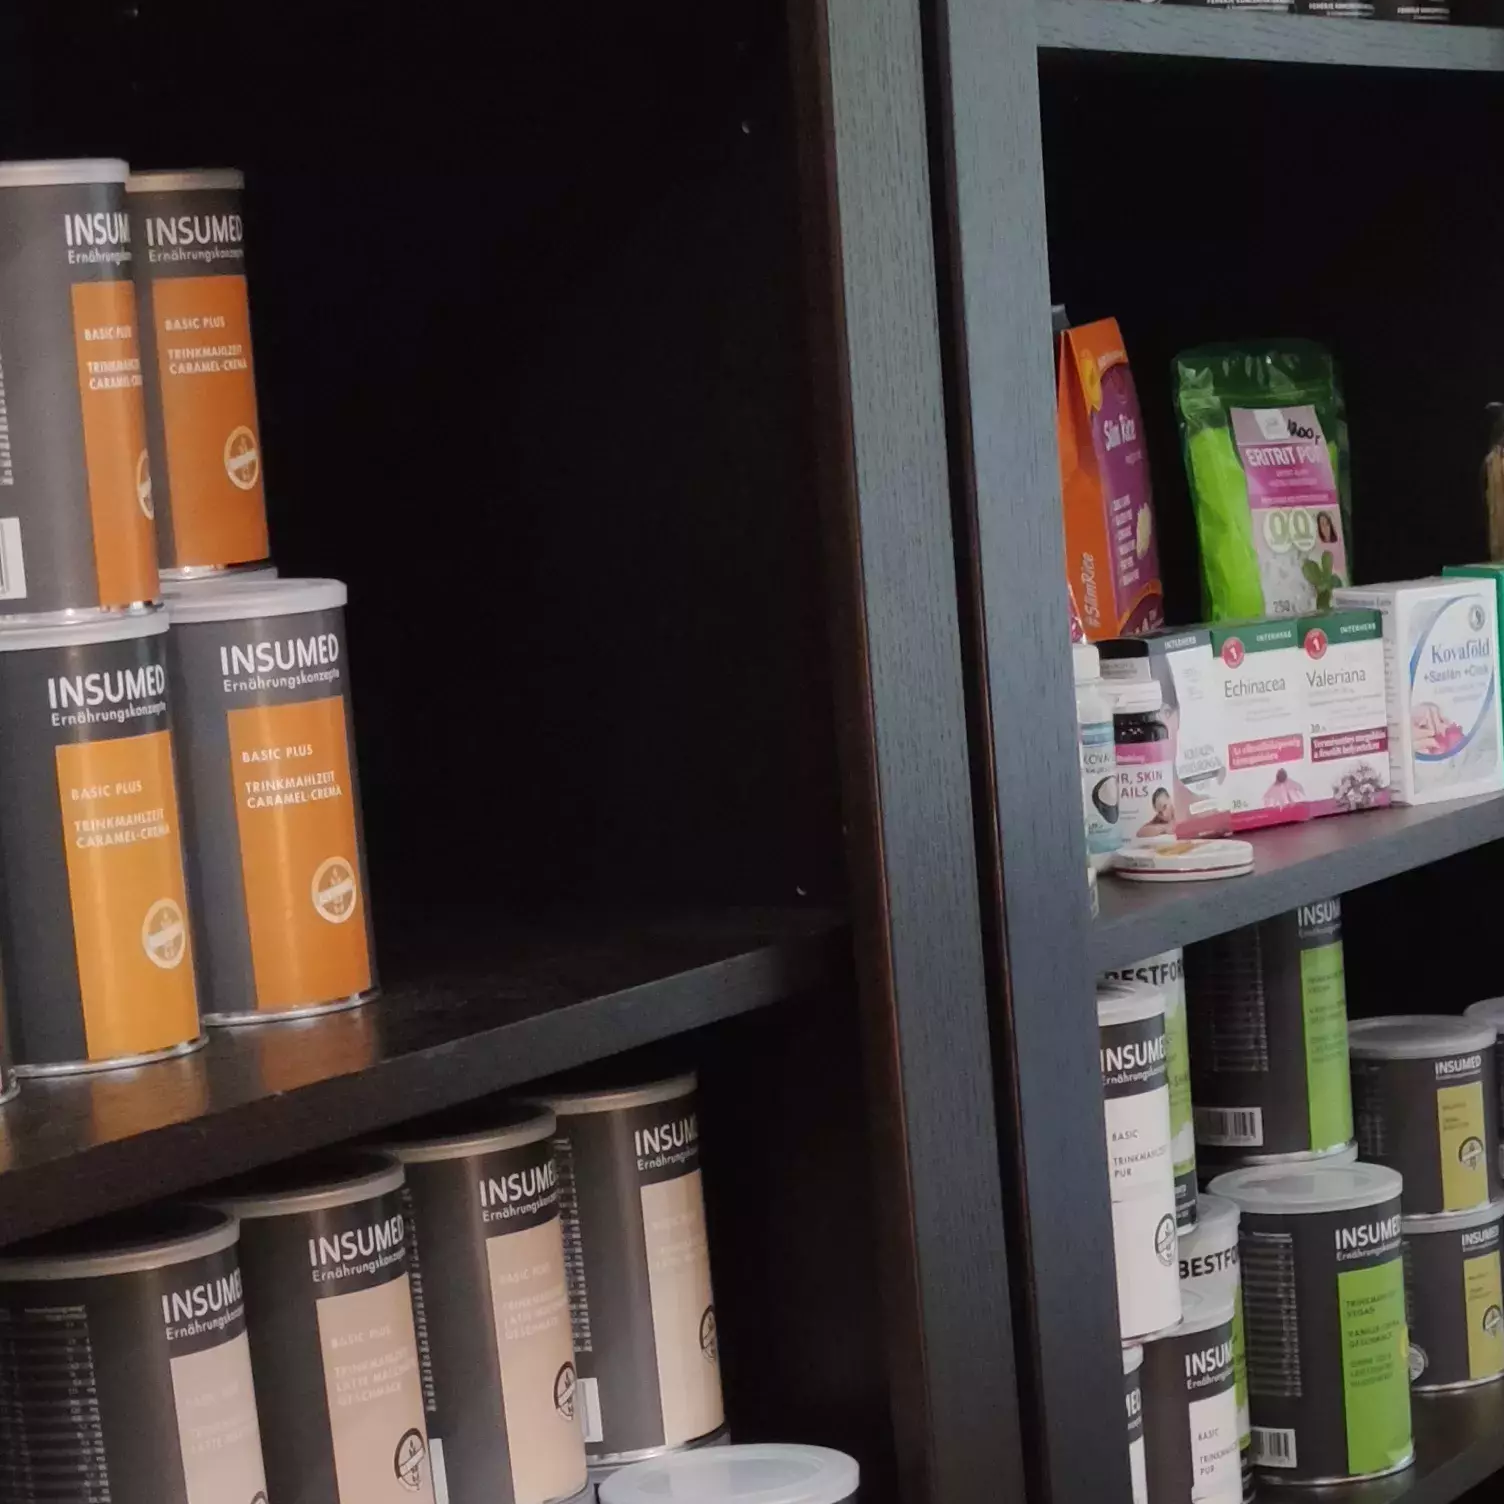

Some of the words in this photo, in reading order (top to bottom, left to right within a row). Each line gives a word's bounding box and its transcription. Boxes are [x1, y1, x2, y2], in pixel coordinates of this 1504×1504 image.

[146, 215, 243, 246] INSUMED
[84, 327, 112, 341] BASIC
[165, 317, 200, 331] BASIC
[203, 316, 226, 329] PLUS
[1246, 445, 1297, 467] ERITRIT
[219, 633, 339, 676] INSUMED
[1431, 637, 1491, 664] Kovaföld
[47, 664, 166, 709] INSUMED
[1224, 676, 1286, 698] Echinacea
[1306, 667, 1367, 688] Valeriana
[242, 748, 281, 763] BASIC
[286, 744, 314, 758] PLUS
[245, 770, 336, 793] TRINKMAHLZEIT
[1136, 770, 1163, 782] SKIN
[71, 785, 110, 801] BASIC
[115, 780, 142, 794] PLUS
[247, 785, 342, 809] CARAMEL-CREMA
[1120, 786, 1149, 798] AILS
[74, 808, 165, 833] TRINKMAHLZEIT
[76, 824, 171, 850] CARAMEL-CREMA
[1435, 1055, 1482, 1076] INSUMED
[1111, 1129, 1139, 1142] BASIC
[1114, 1168, 1132, 1178] PUR
[308, 1214, 404, 1267] INSUMED
[1197, 1427, 1220, 1441] BASIC
[1200, 1465, 1215, 1476] PUR
